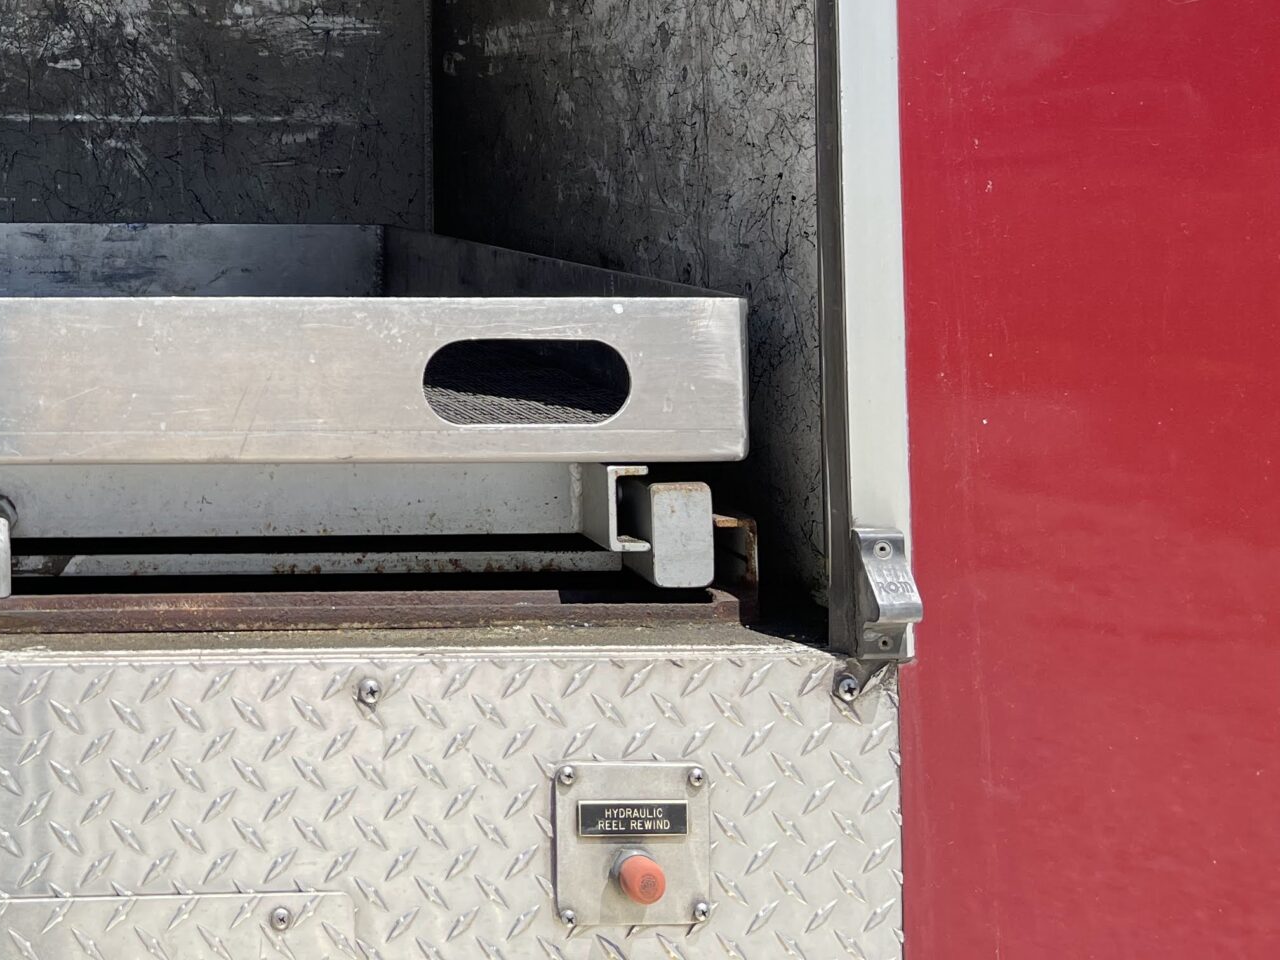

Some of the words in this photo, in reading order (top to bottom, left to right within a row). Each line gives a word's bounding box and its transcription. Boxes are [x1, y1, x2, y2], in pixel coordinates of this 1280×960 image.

[605, 807, 663, 818] HYDRAULIC
[598, 820, 625, 830] REEL
[630, 819, 671, 830] REWIND
